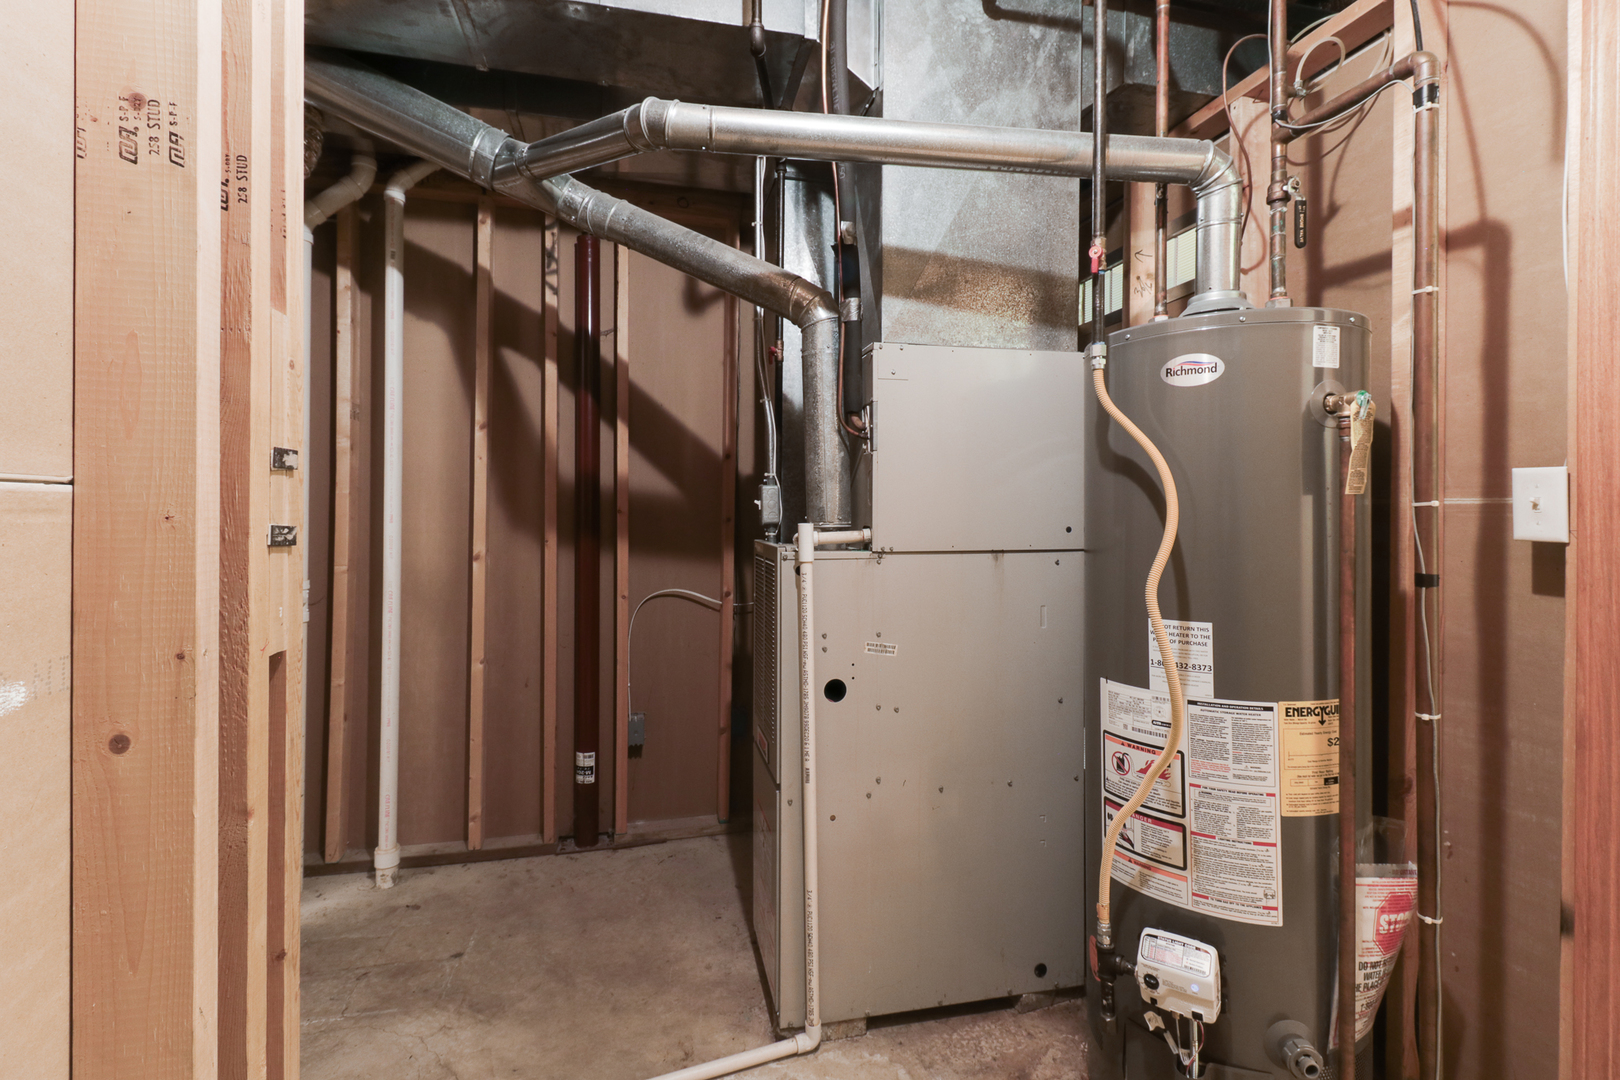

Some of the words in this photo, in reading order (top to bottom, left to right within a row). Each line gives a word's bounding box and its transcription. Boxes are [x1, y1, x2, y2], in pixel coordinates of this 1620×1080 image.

[146, 99, 161, 130] STUD
[235, 154, 248, 182] STUD
[237, 186, 248, 204] 258
[1165, 362, 1218, 378] Richmond
[1285, 704, 1339, 718] ENERGYGUI
[1126, 742, 1156, 755] WARNING
[1132, 814, 1152, 824] ANGER
[1358, 961, 1369, 971] DO
